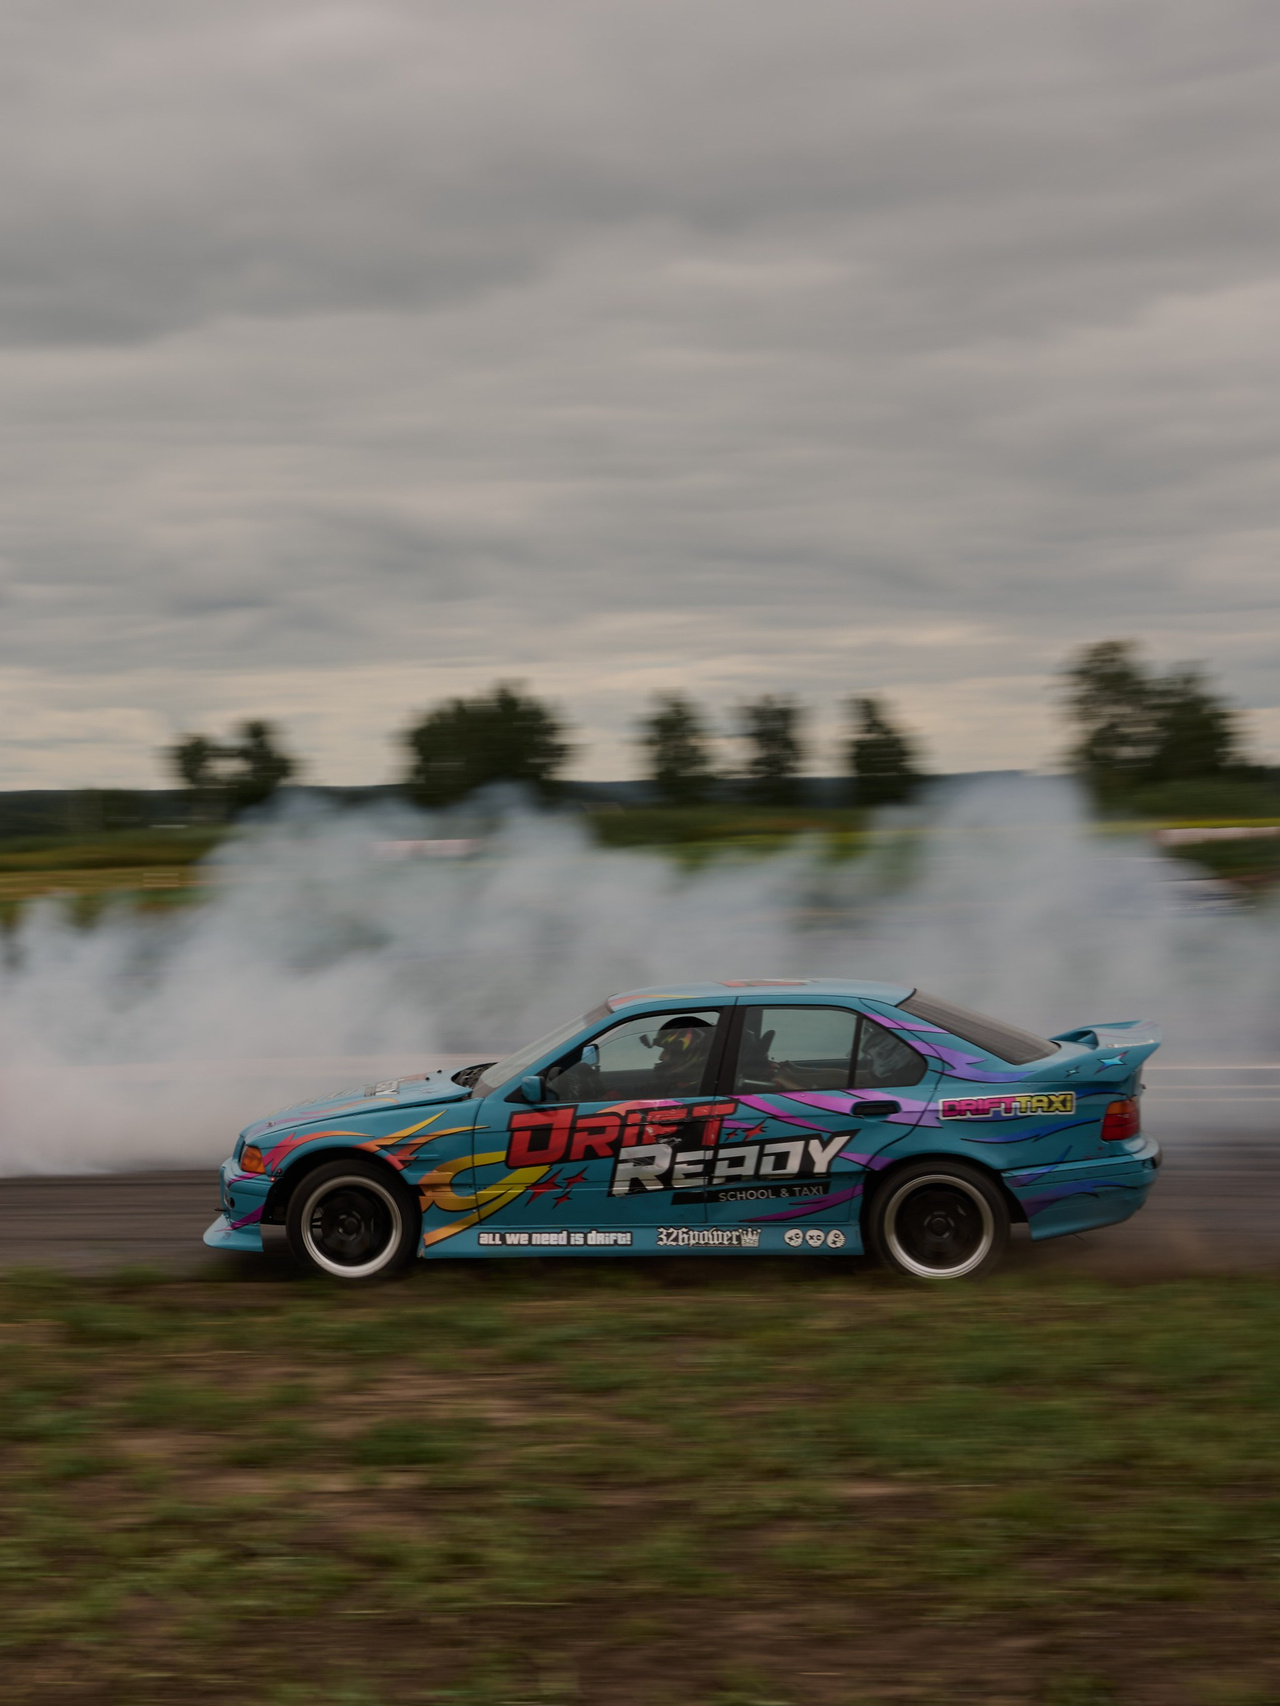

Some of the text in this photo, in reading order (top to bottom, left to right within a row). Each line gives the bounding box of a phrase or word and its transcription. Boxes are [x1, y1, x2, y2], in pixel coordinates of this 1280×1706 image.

[718, 1185, 824, 1202] SCHOOL & TAXI
[531, 1230, 568, 1245] need
[570, 1233, 584, 1245] is
